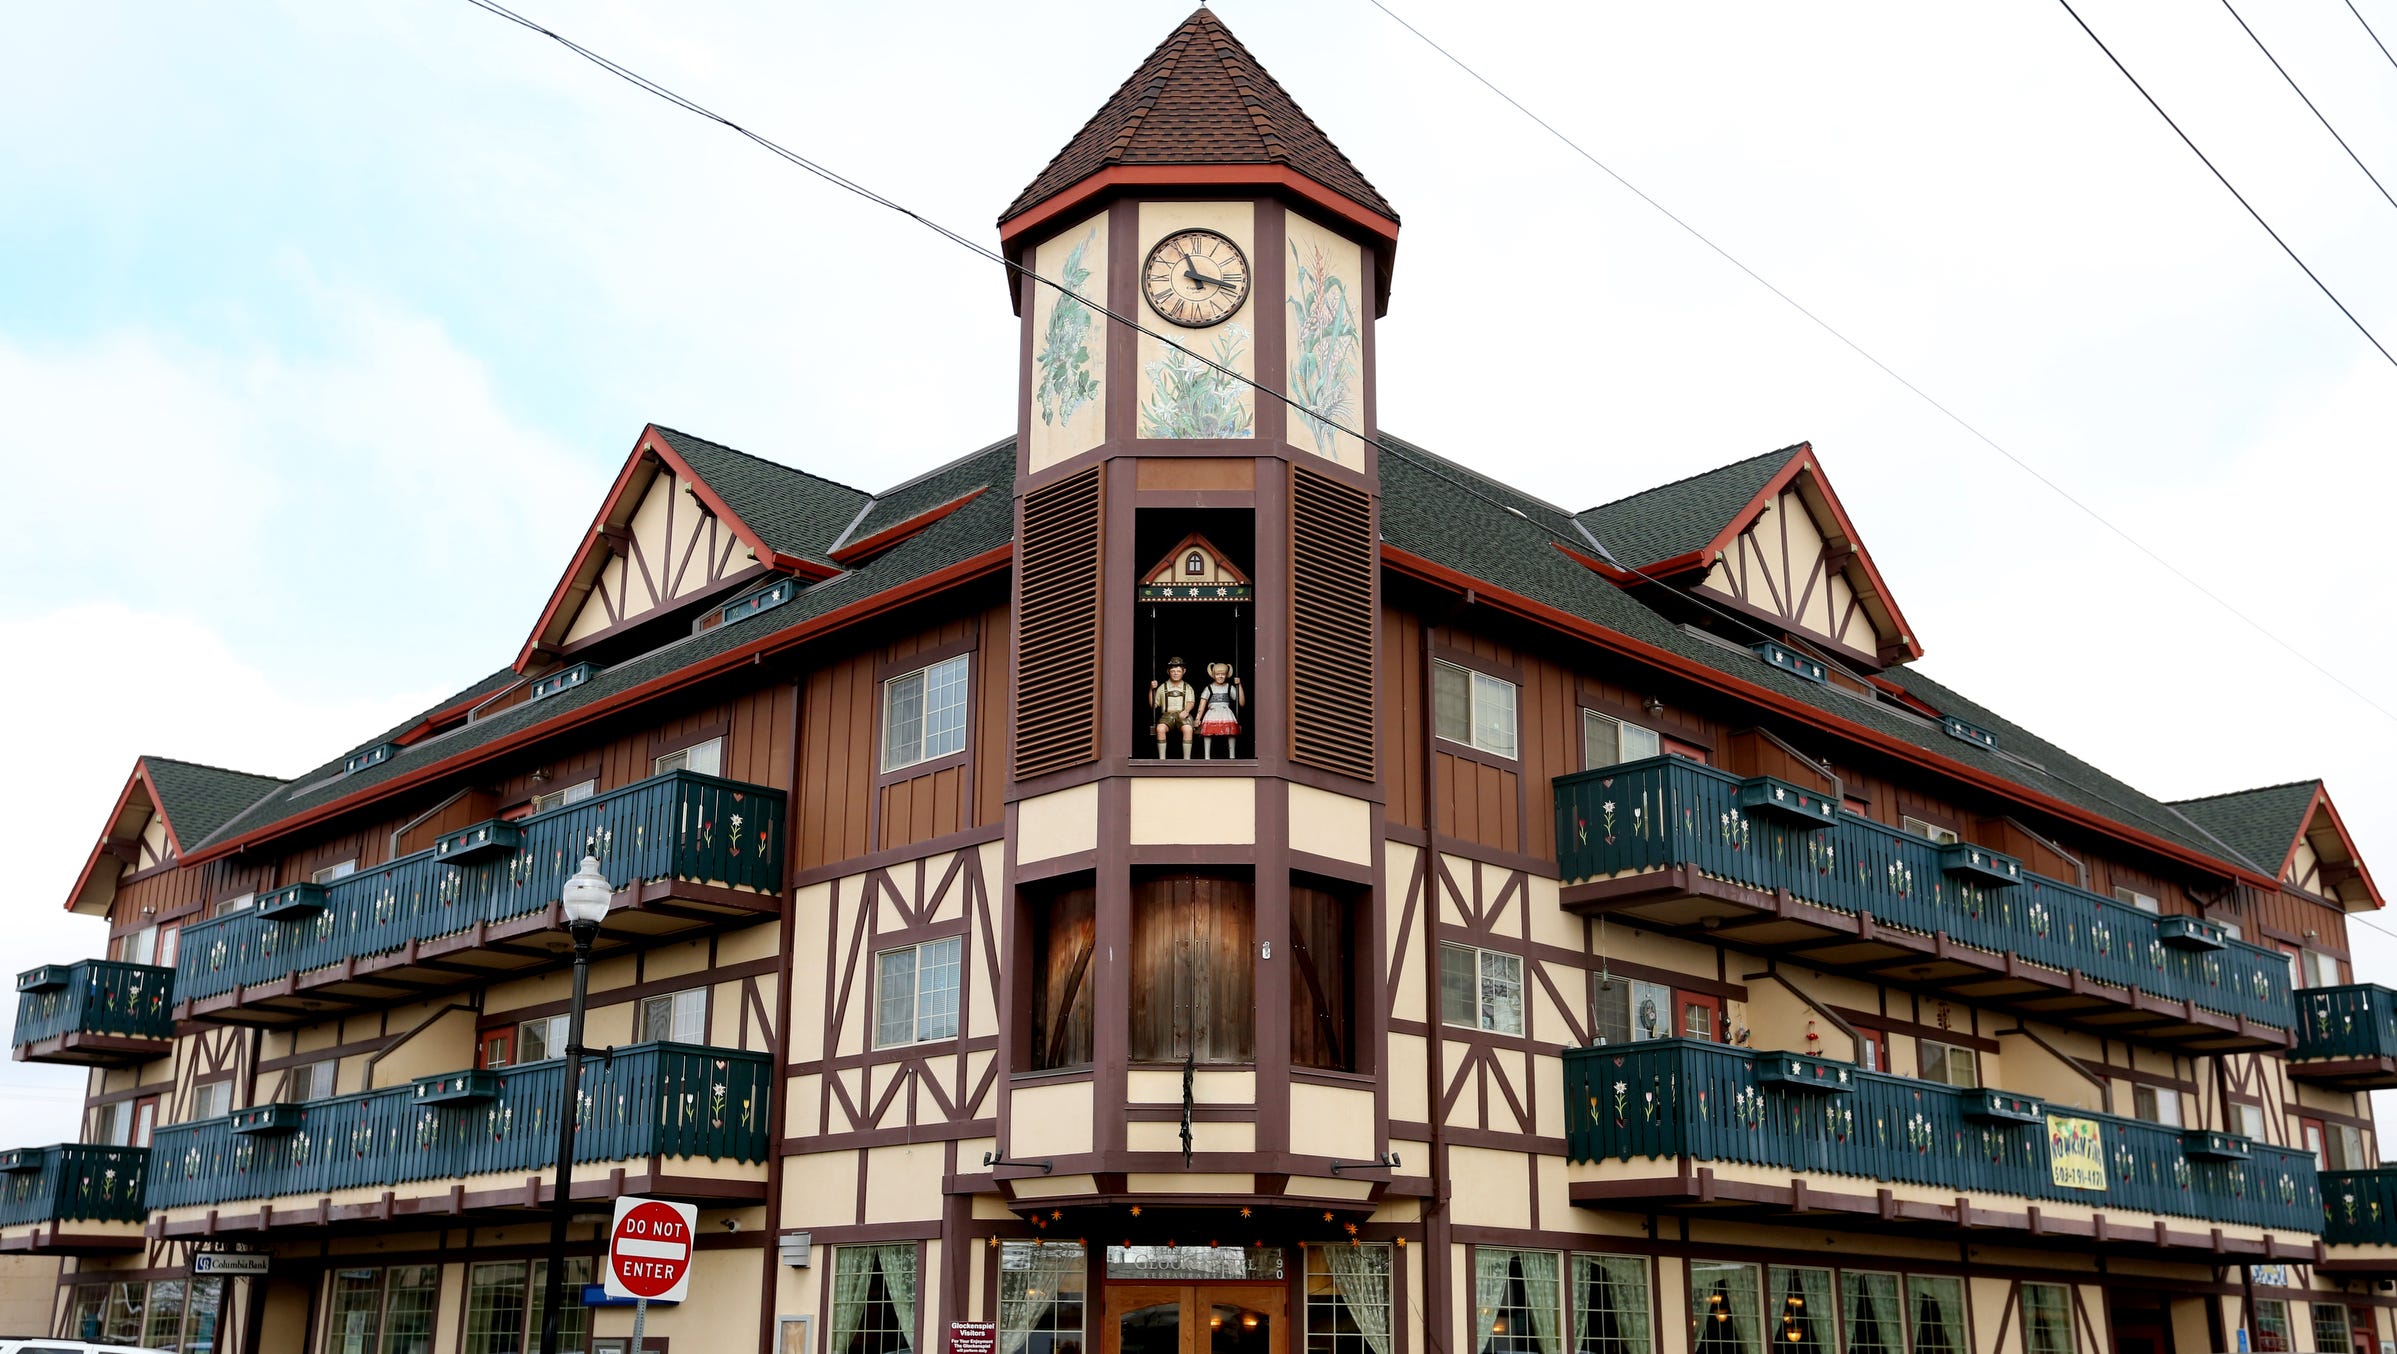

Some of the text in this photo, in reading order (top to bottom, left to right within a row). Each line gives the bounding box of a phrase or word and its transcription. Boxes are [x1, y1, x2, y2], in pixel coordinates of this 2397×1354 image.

[1190, 237, 1202, 254] XII
[1209, 242, 1220, 257] I
[1154, 256, 1175, 269] X
[1218, 256, 1236, 267] II
[1222, 273, 1242, 282] III
[1191, 302, 1203, 320] VI
[1209, 300, 1224, 315] V
[626, 1218, 683, 1238] DO NOT
[623, 1261, 674, 1280] ENTER
[1134, 1254, 1257, 1279] GLOCKPL
[951, 1322, 995, 1330] Glockenspiel
